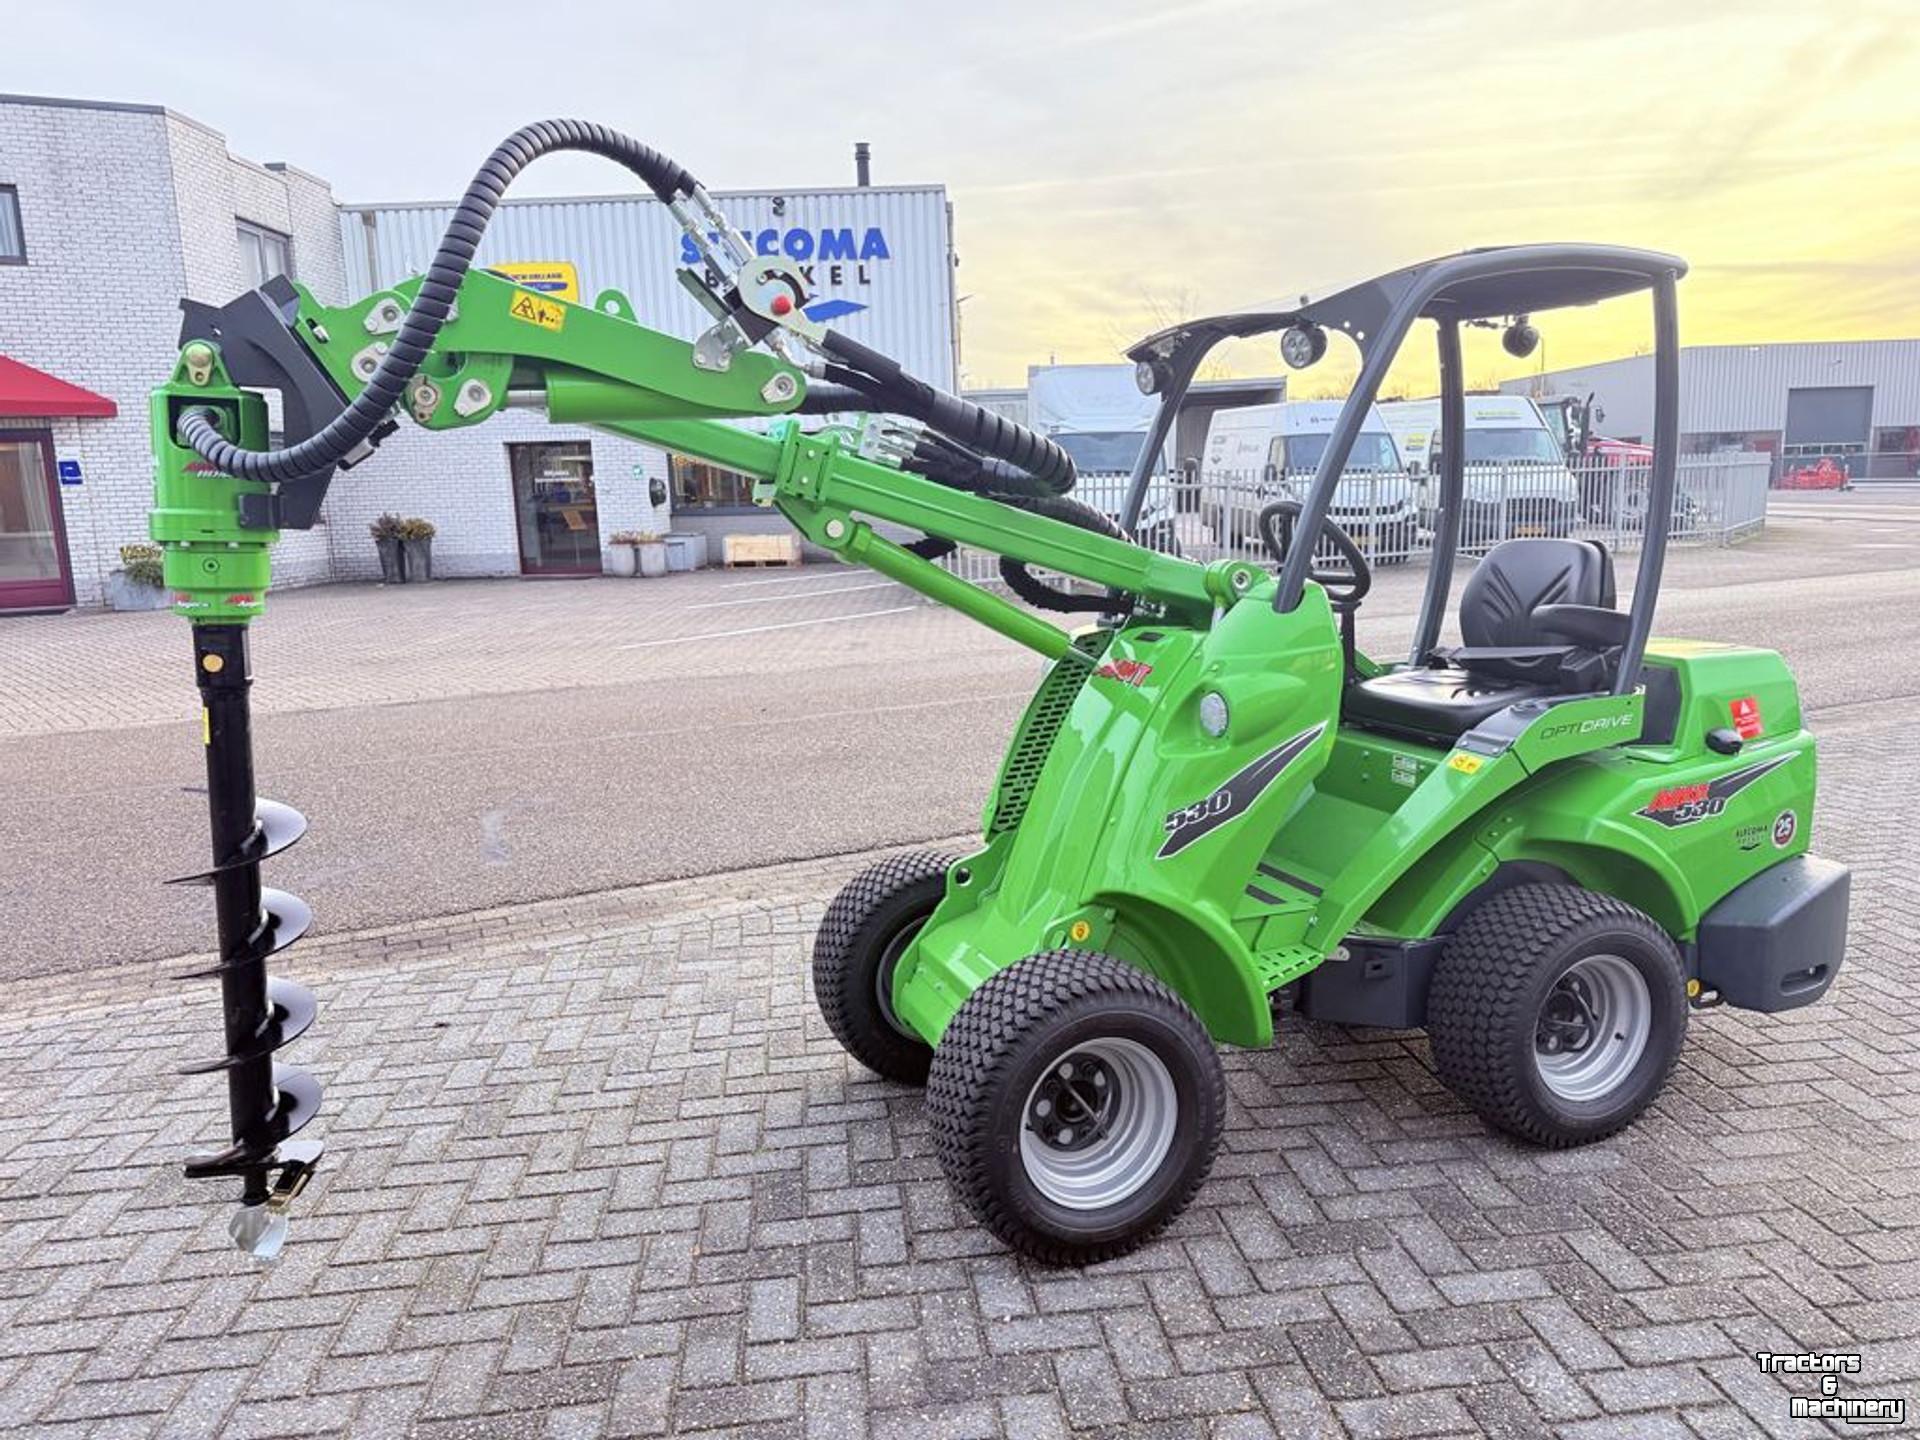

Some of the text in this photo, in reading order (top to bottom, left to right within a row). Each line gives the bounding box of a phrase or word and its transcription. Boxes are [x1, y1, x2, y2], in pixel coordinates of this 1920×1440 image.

[1540, 712, 1634, 740] OPTIDRIVE
[1163, 789, 1232, 834] 530
[1673, 797, 1725, 821] 530
[1776, 817, 1792, 838] 25
